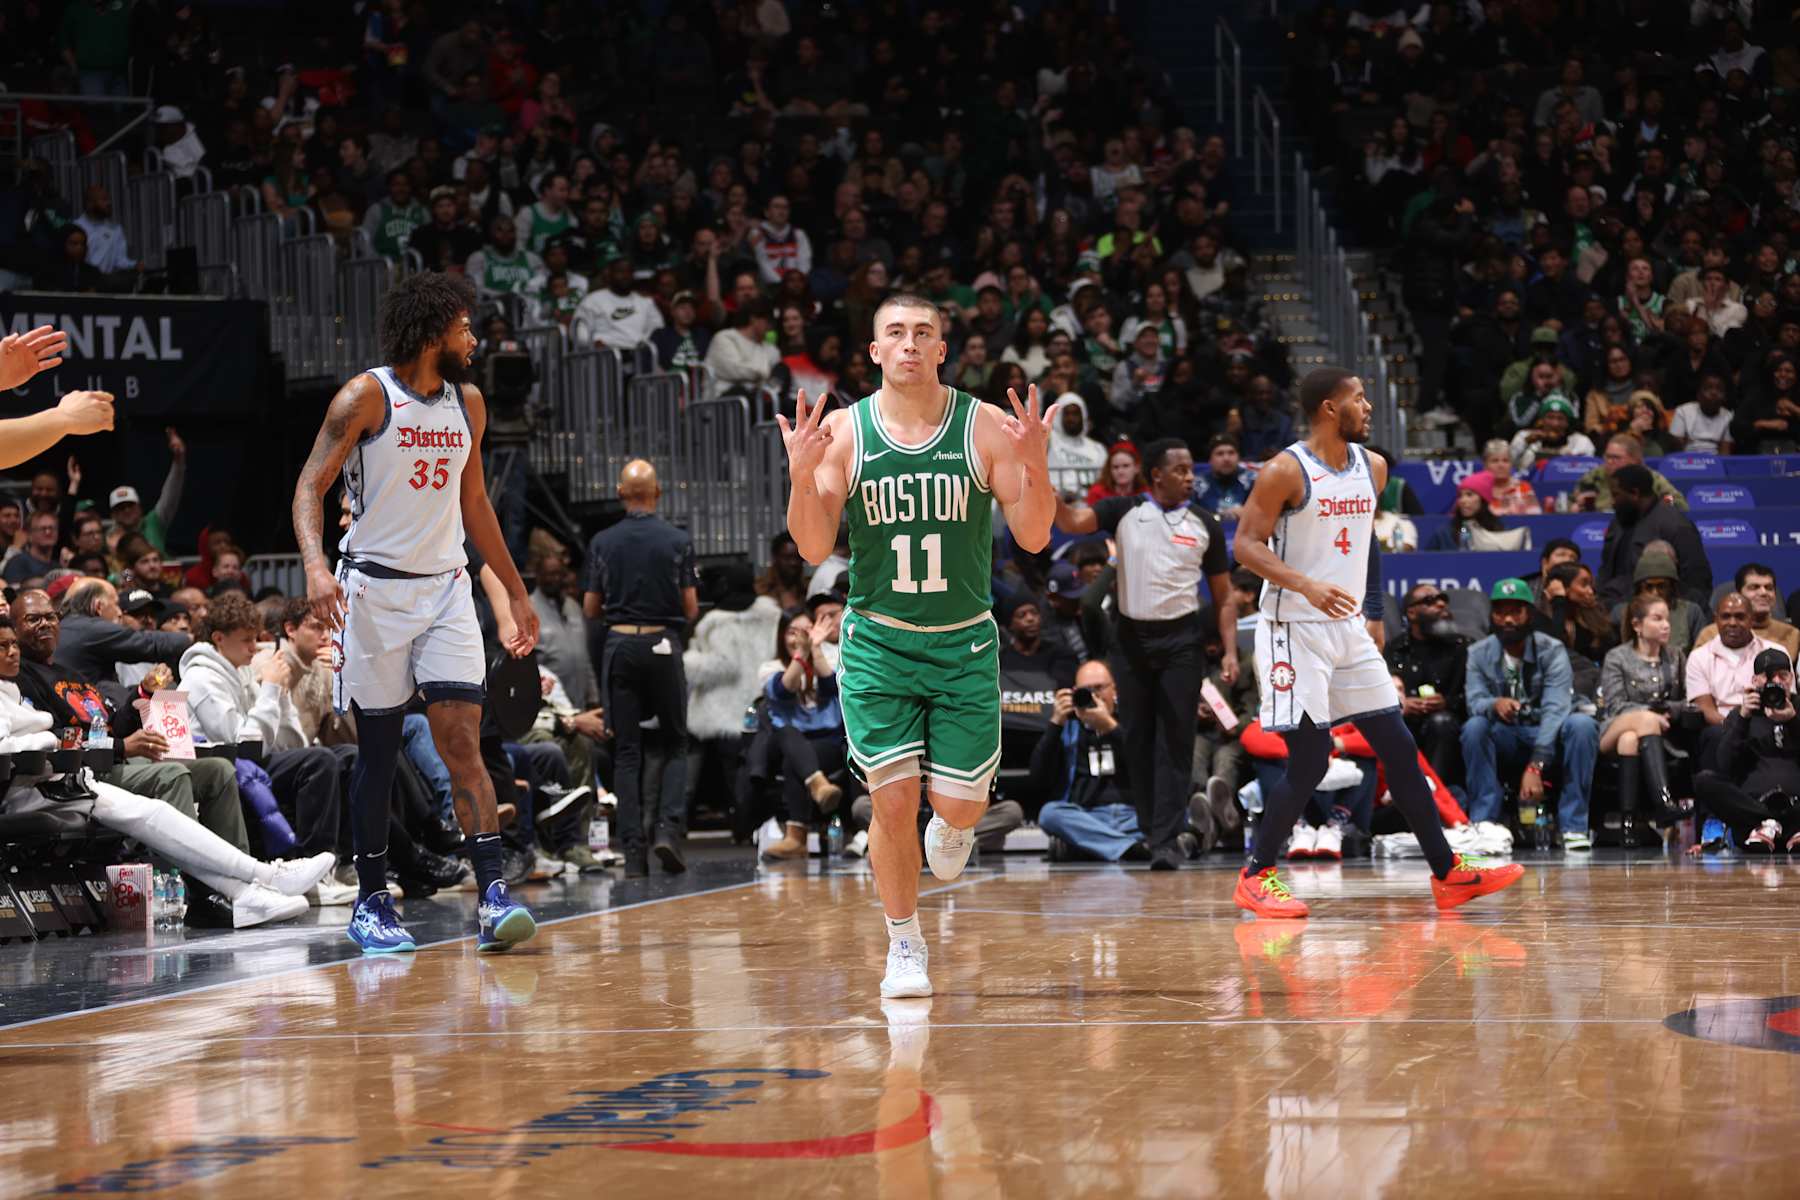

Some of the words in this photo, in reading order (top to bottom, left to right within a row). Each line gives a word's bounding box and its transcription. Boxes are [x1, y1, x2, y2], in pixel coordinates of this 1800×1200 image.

[397, 425, 464, 448] District
[932, 451, 964, 461] Amica
[408, 458, 450, 490] 35
[860, 473, 970, 527] BOSTON
[1317, 495, 1372, 517] District
[1334, 527, 1352, 556] 4
[890, 533, 948, 594] 11
